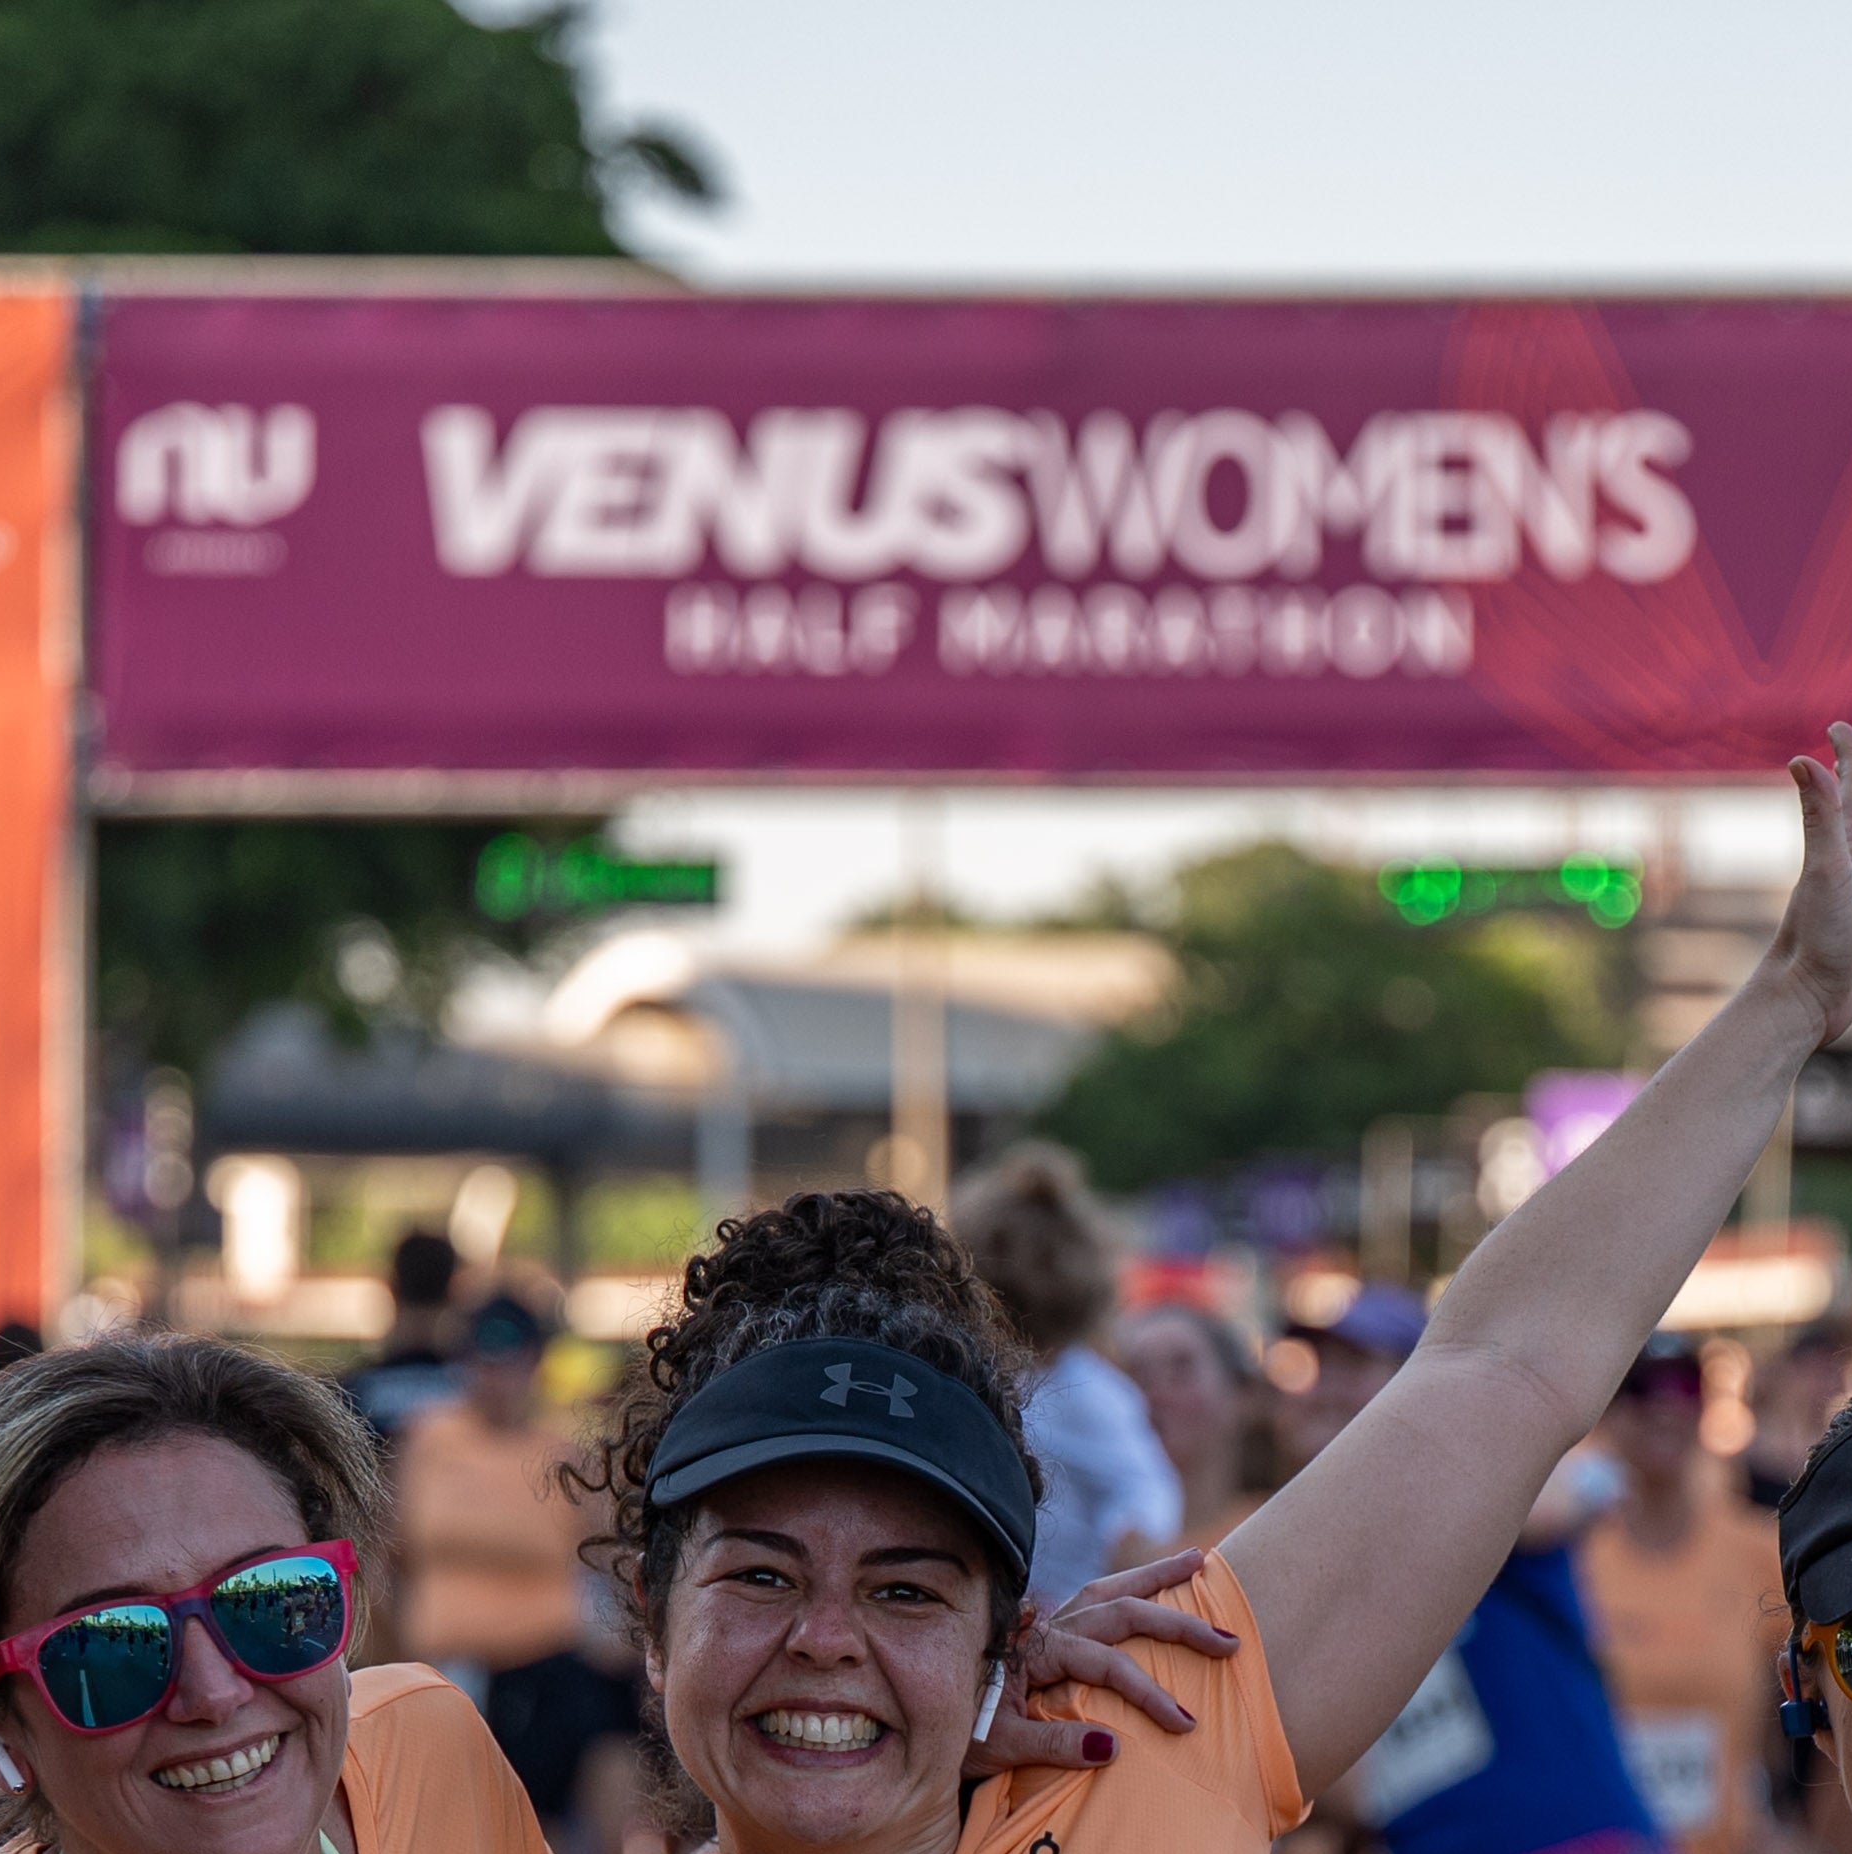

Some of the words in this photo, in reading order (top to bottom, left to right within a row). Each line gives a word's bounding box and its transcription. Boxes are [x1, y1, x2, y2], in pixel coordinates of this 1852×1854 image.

[421, 402, 1029, 580] VENUS
[664, 582, 917, 678] HALF
[939, 582, 1474, 680] MARATHON
